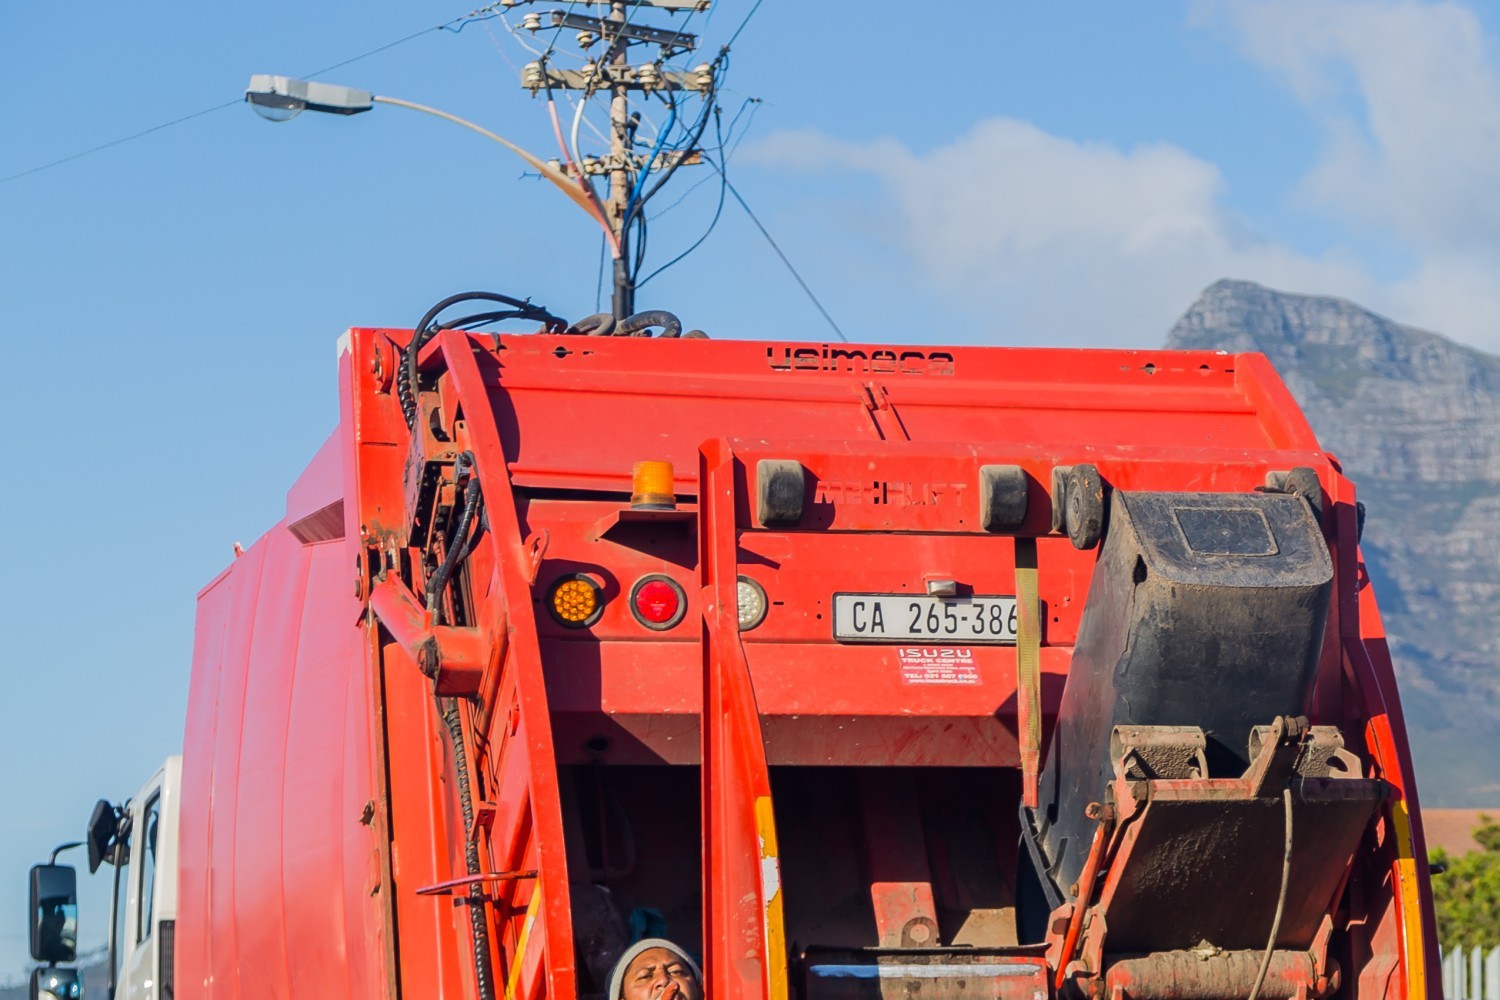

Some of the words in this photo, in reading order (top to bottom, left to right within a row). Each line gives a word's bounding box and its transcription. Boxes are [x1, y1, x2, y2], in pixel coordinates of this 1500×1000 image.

[853, 601, 885, 633] CA
[908, 602, 1017, 635] 265-386
[899, 648, 972, 658] ISUZU
